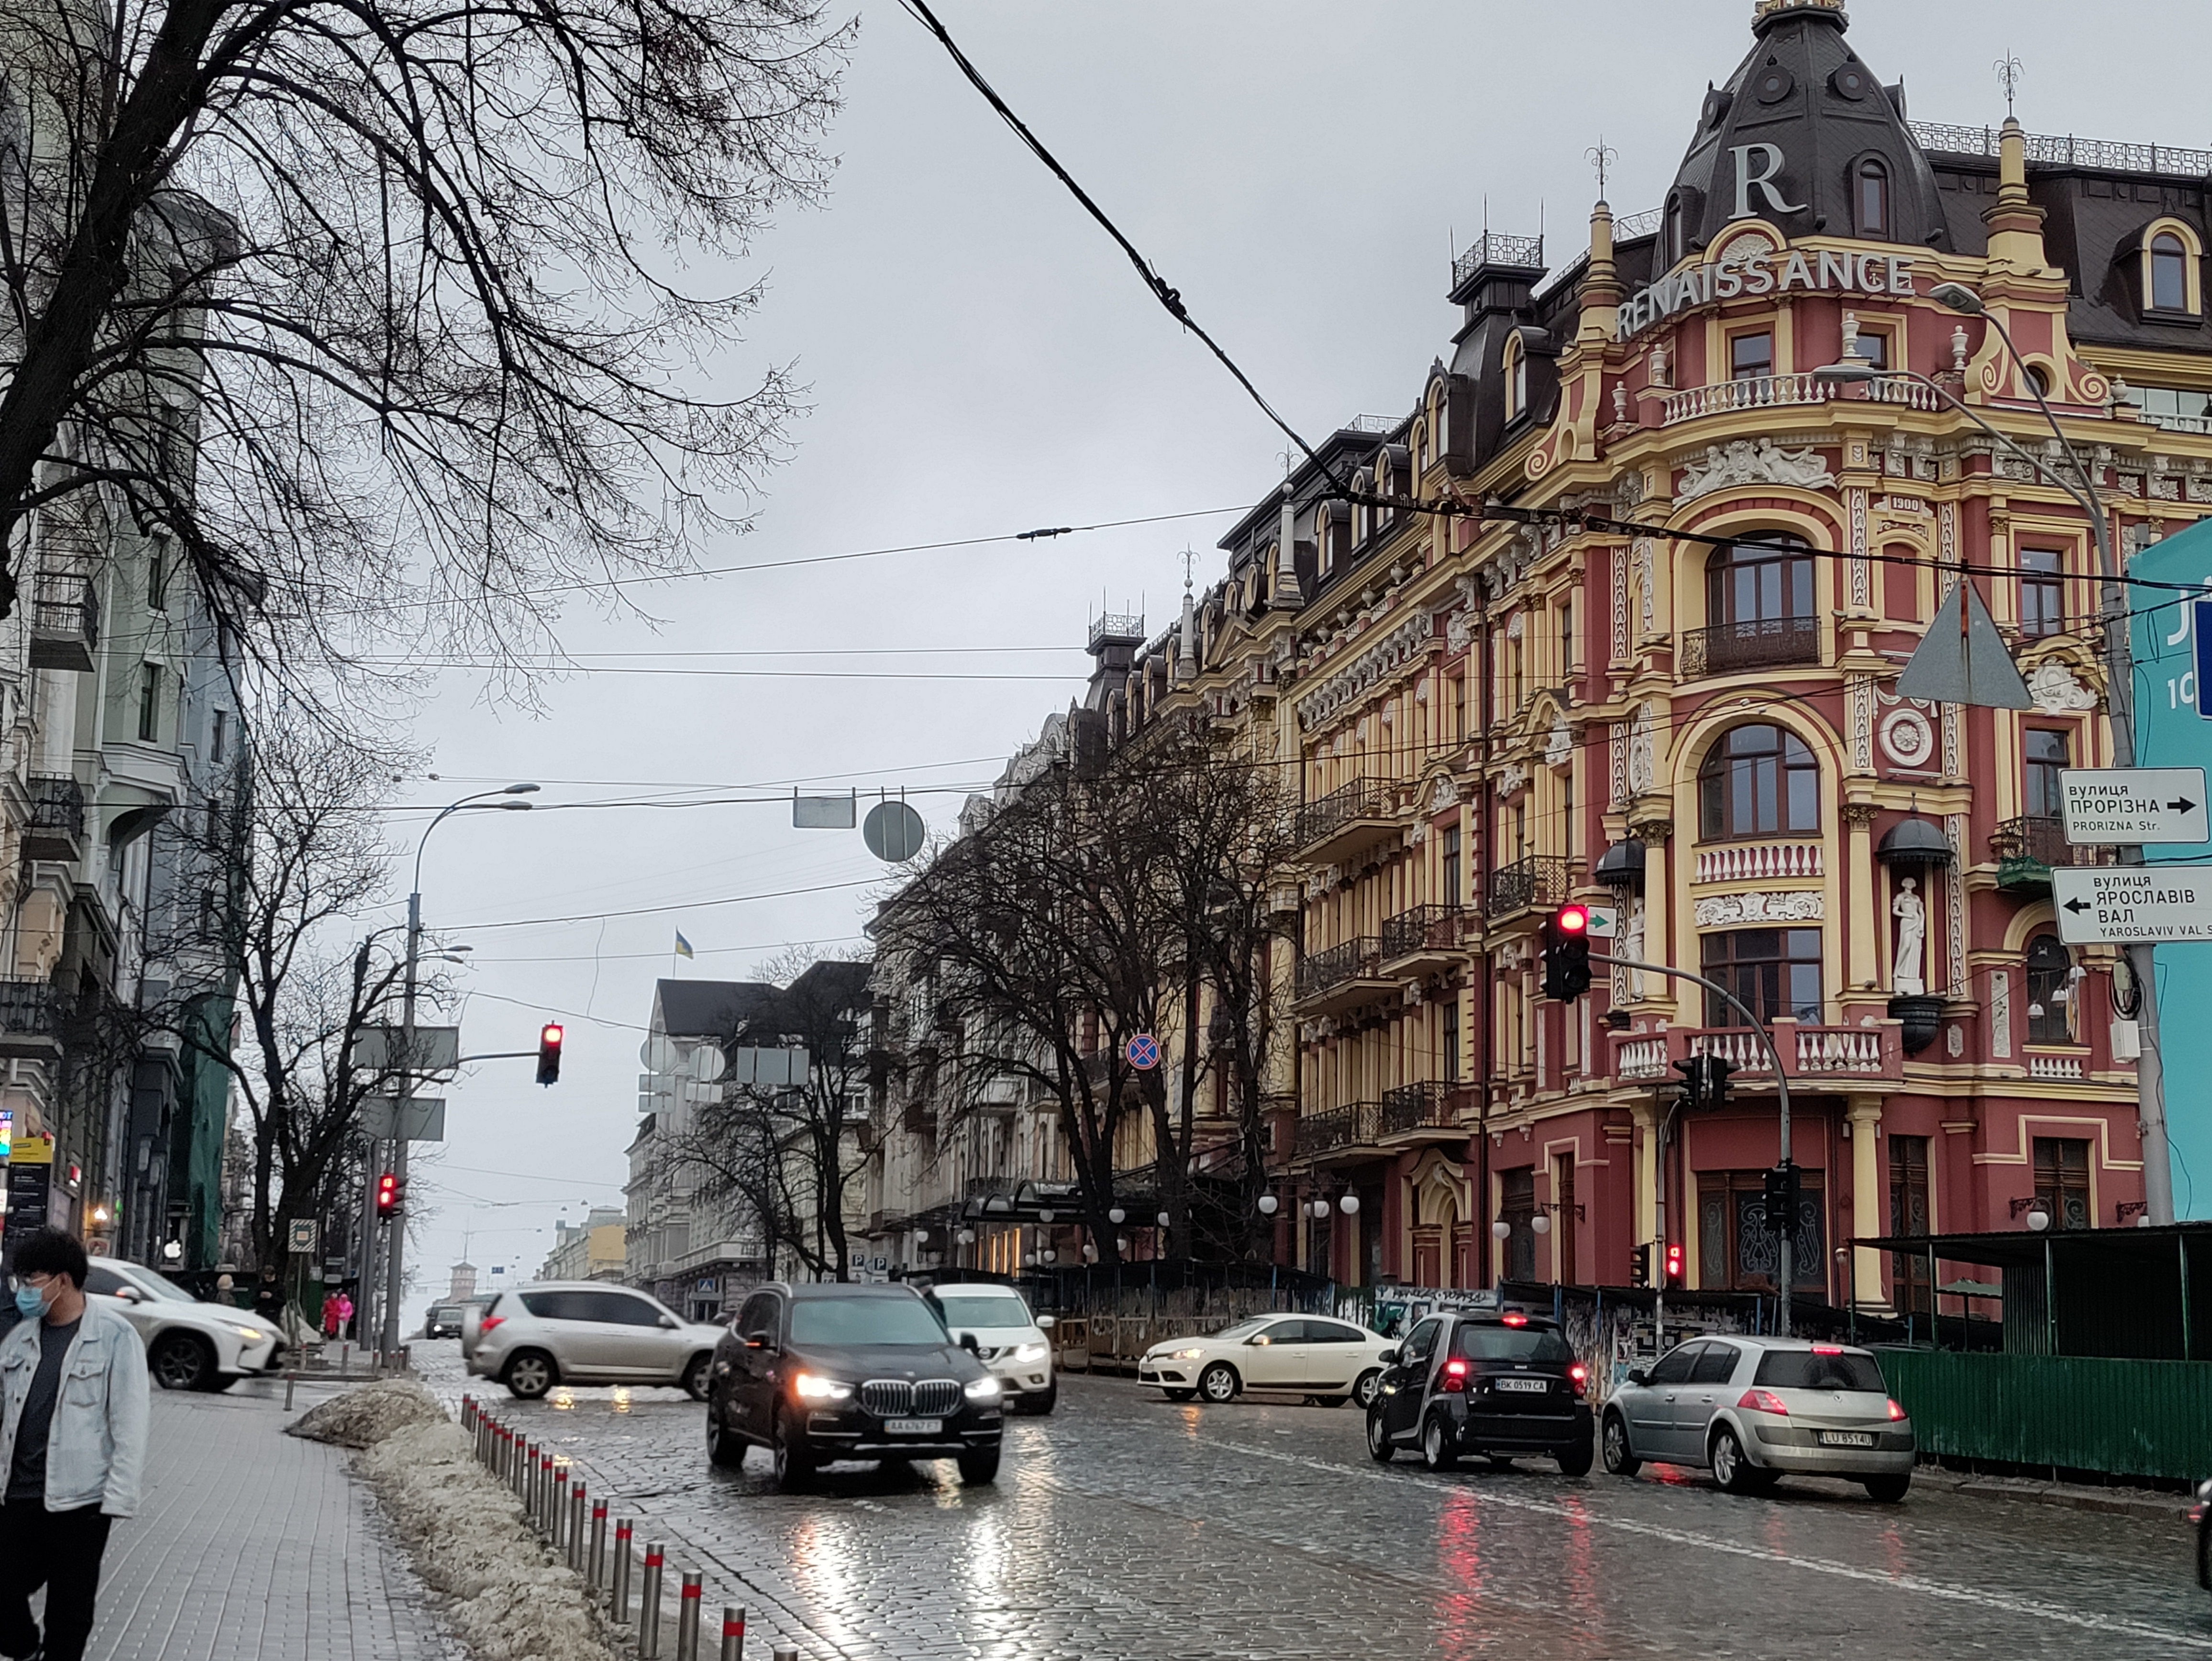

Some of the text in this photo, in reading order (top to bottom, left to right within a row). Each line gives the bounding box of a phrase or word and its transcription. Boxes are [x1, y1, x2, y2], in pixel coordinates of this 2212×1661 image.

[1727, 142, 1810, 220] R
[1616, 251, 1915, 343] RENAISSANCE
[1892, 497, 1919, 511] 1900
[2069, 786, 2129, 799] вулиця
[2070, 799, 2160, 813] ПРОРІЗНА
[2073, 820, 2160, 830] PRORIZNA Str.
[2093, 876, 2151, 891] вулиця
[2096, 889, 2195, 905] ЯРОСЛАВІВ
[2098, 908, 2135, 923] ВАЛ
[2100, 926, 2174, 937] YAROSLAVIV
[2179, 925, 2202, 935] VAL
[854, 1255, 863, 1266] P
[876, 1258, 885, 1270] P
[1501, 1380, 1545, 1390] BK 0519 CA
[1825, 1433, 1839, 1443] LU
